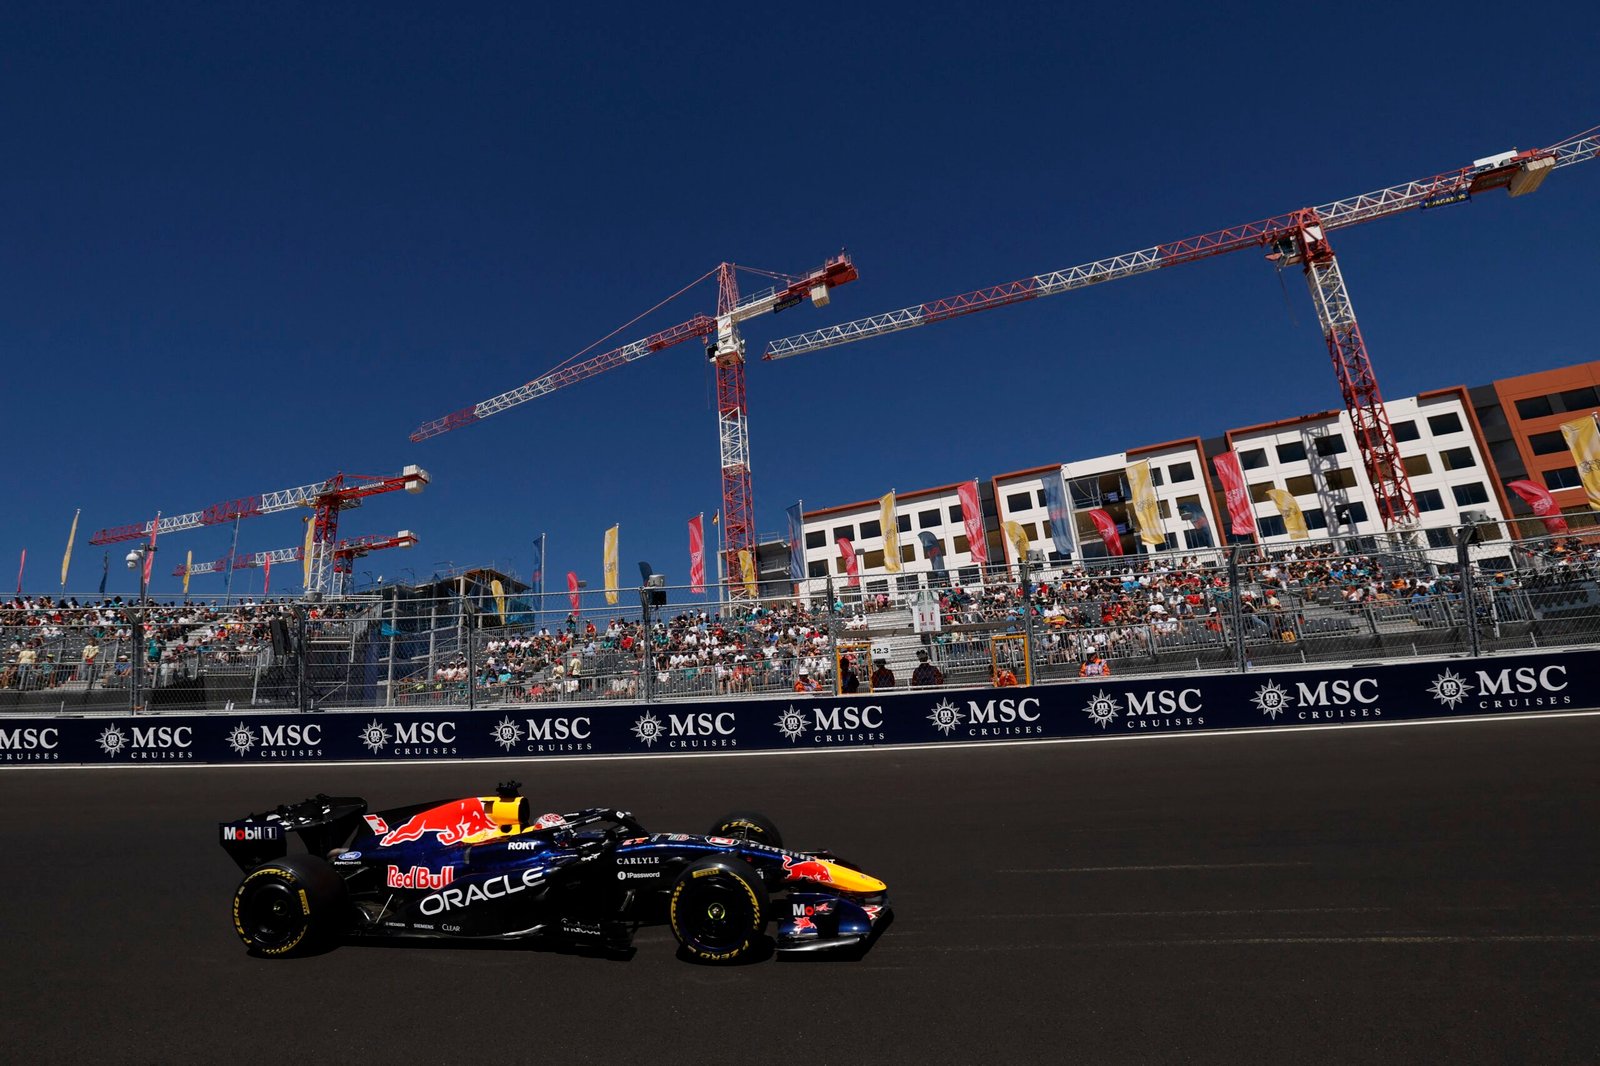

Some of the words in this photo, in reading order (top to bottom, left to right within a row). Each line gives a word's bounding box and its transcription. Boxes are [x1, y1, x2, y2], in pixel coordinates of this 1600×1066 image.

[872, 647, 889, 655] 12.3
[1476, 666, 1567, 695] MSC
[1125, 689, 1202, 716] MSC
[1296, 679, 1378, 706] MSC
[1480, 697, 1570, 708] CRUISES
[813, 706, 882, 730] MSC
[968, 698, 1040, 723] MSC
[1299, 709, 1380, 719] CRUISES
[394, 722, 455, 743] MSC
[527, 717, 590, 740] MSC
[669, 713, 735, 736] MSC
[970, 726, 1041, 735] CRUISES
[1128, 718, 1203, 728] CRUISES
[0, 728, 58, 749] MSC
[132, 727, 192, 747] MSC
[261, 725, 321, 746] MSC
[815, 733, 884, 742] CRUISES
[224, 826, 262, 840] Mobil
[730, 820, 764, 833] ZERO
[508, 842, 538, 850] ROKT
[616, 856, 660, 864] CARLYLE
[387, 865, 416, 889] Red
[415, 866, 454, 890] Bull
[692, 868, 720, 879] PIRELLI
[420, 866, 546, 916] ORACLE
[234, 896, 245, 934] ZERO
[442, 923, 460, 932] CLEAR
[700, 948, 740, 960] ZERO
